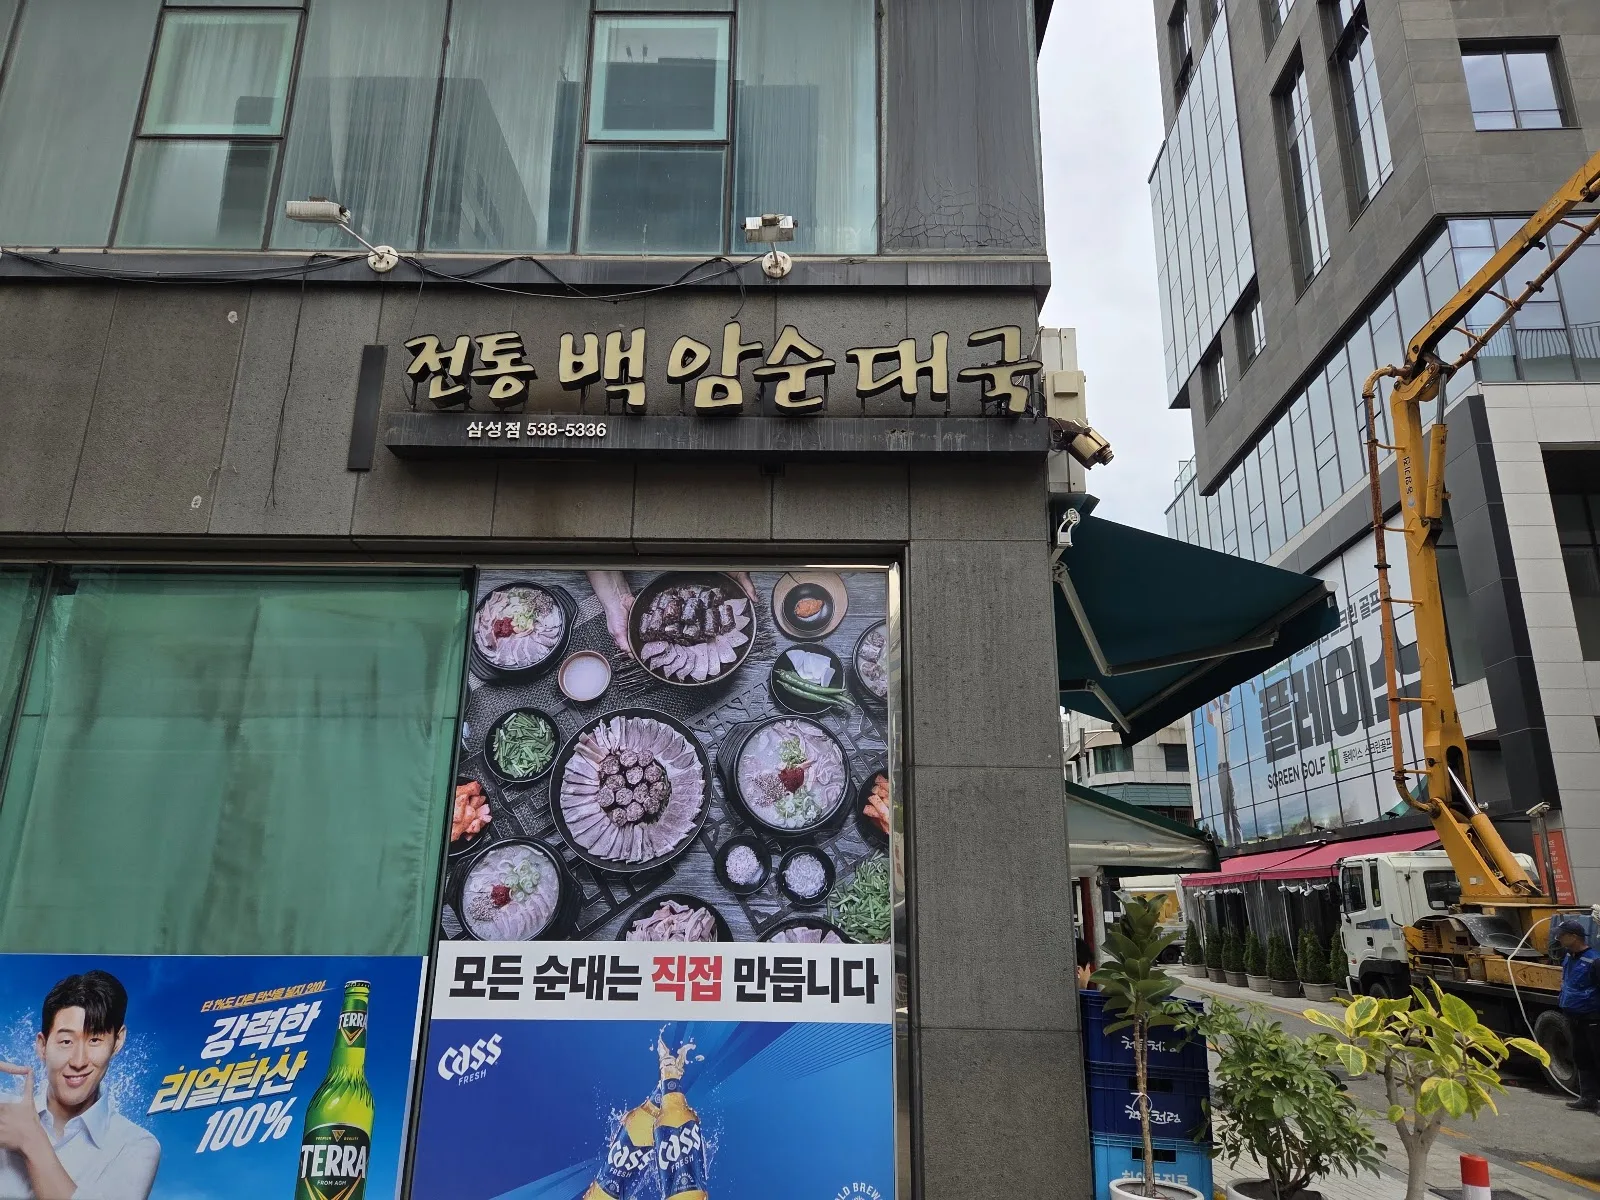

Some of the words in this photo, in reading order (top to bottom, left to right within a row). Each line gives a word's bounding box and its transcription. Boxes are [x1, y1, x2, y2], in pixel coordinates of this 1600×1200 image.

[402, 330, 537, 407] 전통
[466, 421, 521, 439] 삼성점
[526, 422, 607, 437] 538-5336
[1359, 588, 1382, 620] 골프
[1267, 764, 1300, 789] SCREEN
[1302, 756, 1326, 780] GOLF
[449, 955, 523, 1001] 모든
[533, 955, 642, 1001] 순대는
[651, 955, 722, 1002] 직접
[733, 956, 880, 1004] 만듭니다
[201, 1000, 323, 1060] 강력한
[338, 1012, 367, 1030] TERRA
[147, 1047, 308, 1115] 리얼탄산
[458, 1068, 487, 1086] FRESH
[195, 1097, 298, 1154] 100%
[1124, 1104, 1182, 1123] 처처럼
[301, 1144, 367, 1179] TERRA
[609, 1167, 633, 1178] FRESH
[671, 1155, 694, 1173] FRESH
